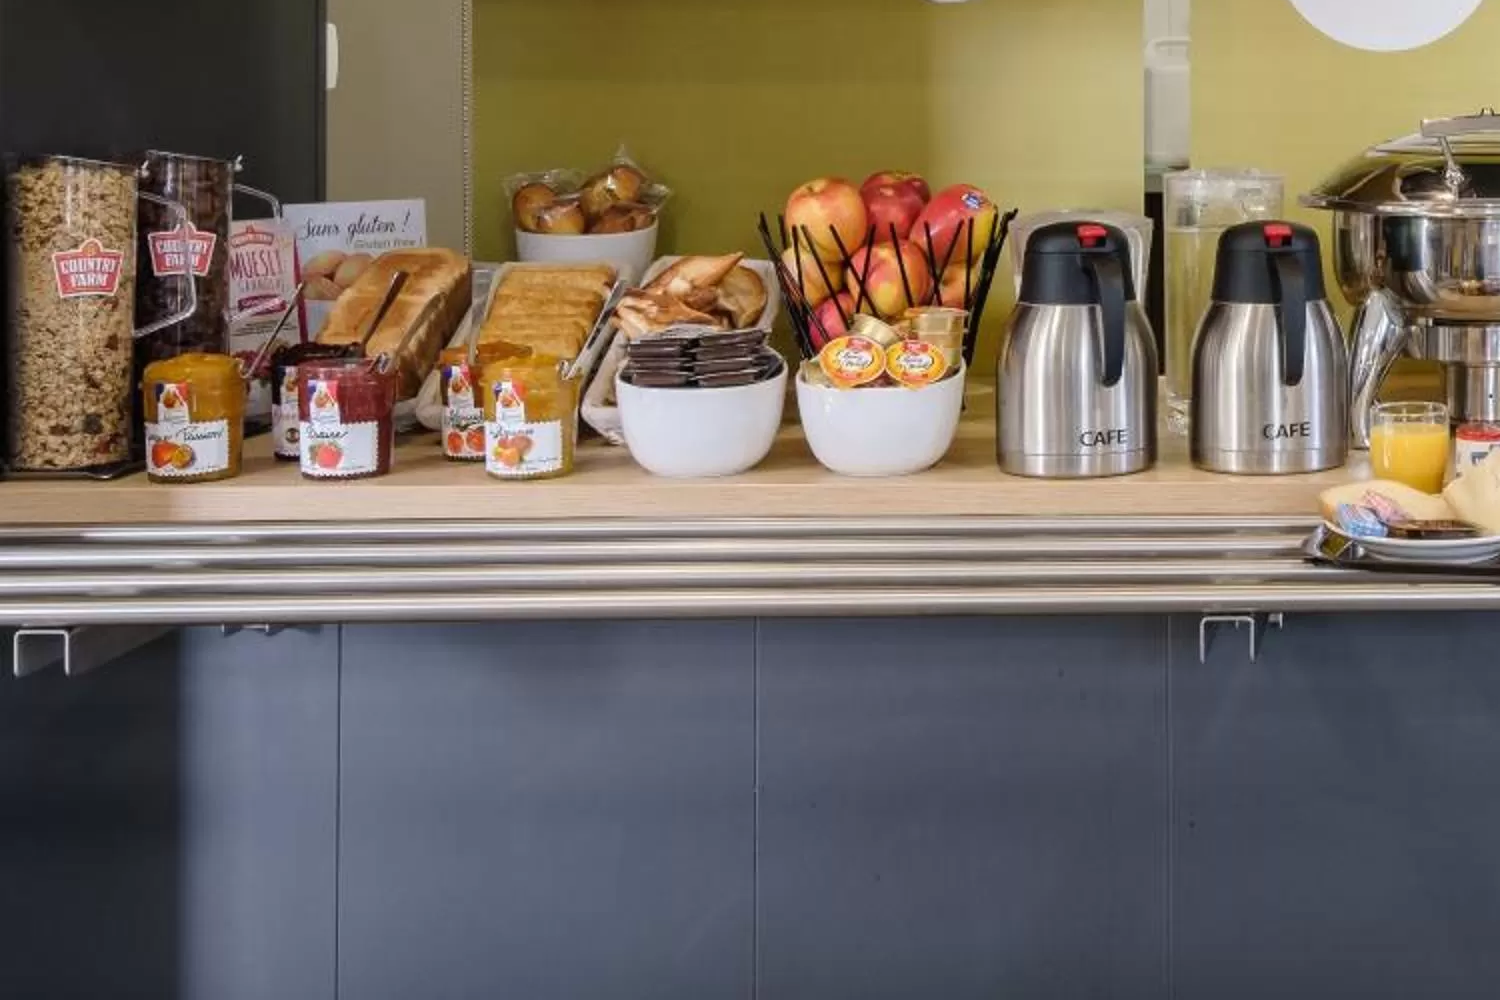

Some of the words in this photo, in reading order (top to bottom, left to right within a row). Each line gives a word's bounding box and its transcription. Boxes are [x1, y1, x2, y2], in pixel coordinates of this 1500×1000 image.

[347, 212, 396, 245] gluten
[60, 257, 117, 273] COUNTRY
[71, 273, 108, 287] FARM
[1080, 429, 1128, 447] CAFE
[1262, 421, 1311, 441] CAFE
